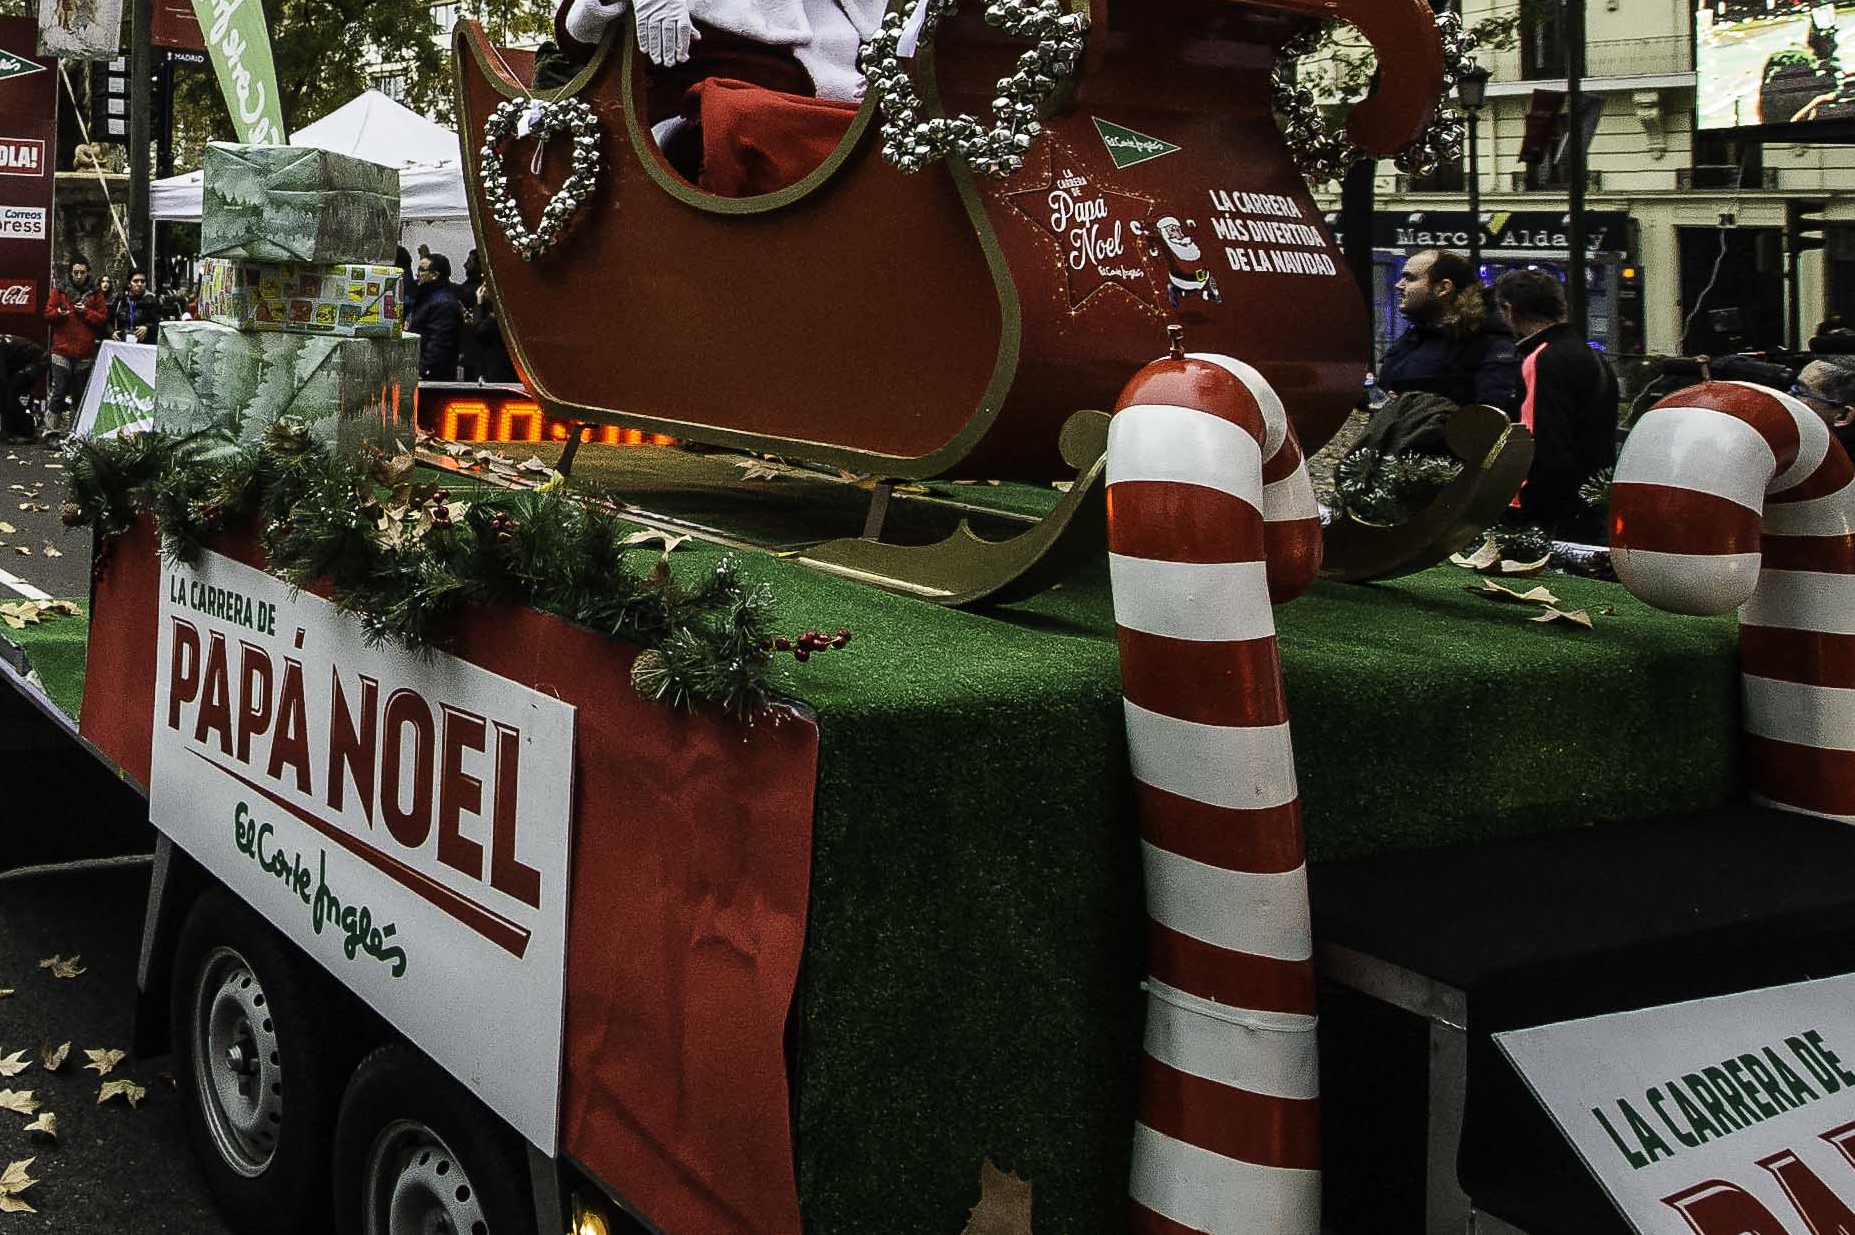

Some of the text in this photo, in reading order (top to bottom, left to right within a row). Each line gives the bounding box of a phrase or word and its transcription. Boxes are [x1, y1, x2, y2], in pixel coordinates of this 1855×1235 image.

[174, 53, 205, 63] MADRID
[5, 209, 42, 220] Correos
[1048, 190, 1108, 232] Papá
[1209, 189, 1303, 219] LA CARRERA
[1069, 219, 1124, 270] Noel
[1210, 213, 1249, 242] MÁS
[1246, 220, 1327, 247] DIVERTIDA
[1225, 247, 1337, 276] DE LA NAVIDAD
[170, 574, 276, 636] LA CARRERA DE
[168, 614, 541, 910] PAPÁ NOEL
[235, 801, 407, 978] El Corte Inglés
[1591, 1029, 1855, 1170] LA CARRERA DE
